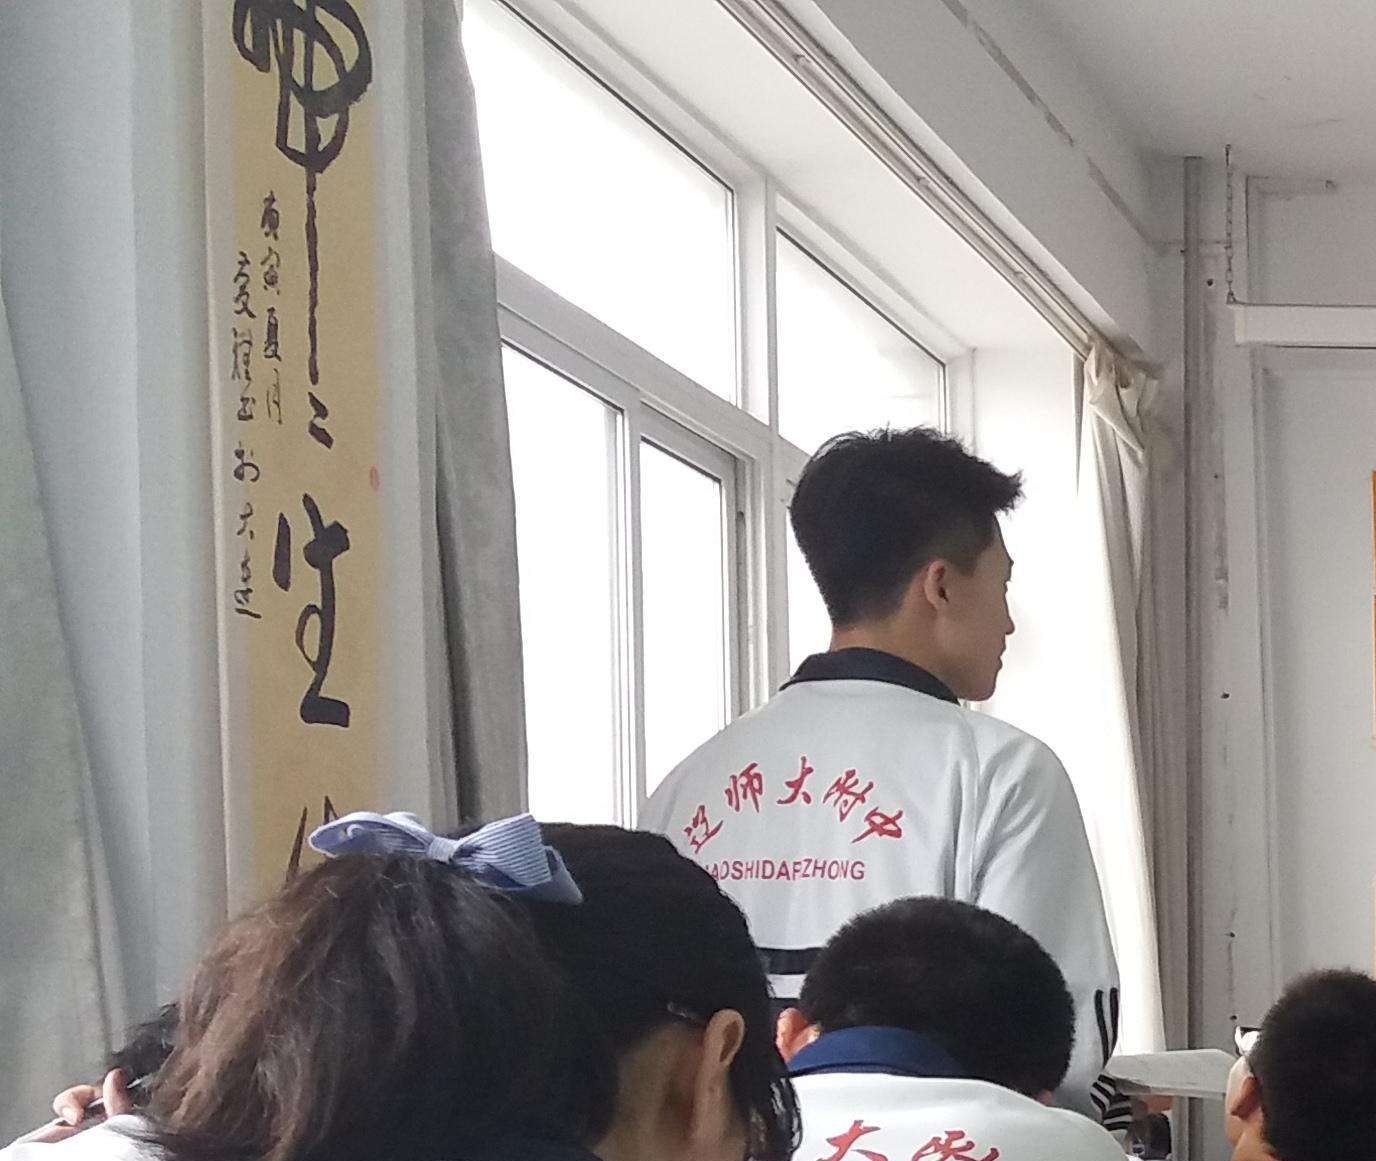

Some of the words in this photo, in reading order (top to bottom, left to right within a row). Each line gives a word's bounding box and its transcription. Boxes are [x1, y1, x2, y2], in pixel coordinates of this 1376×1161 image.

[684, 757, 904, 854] 辽师大附中
